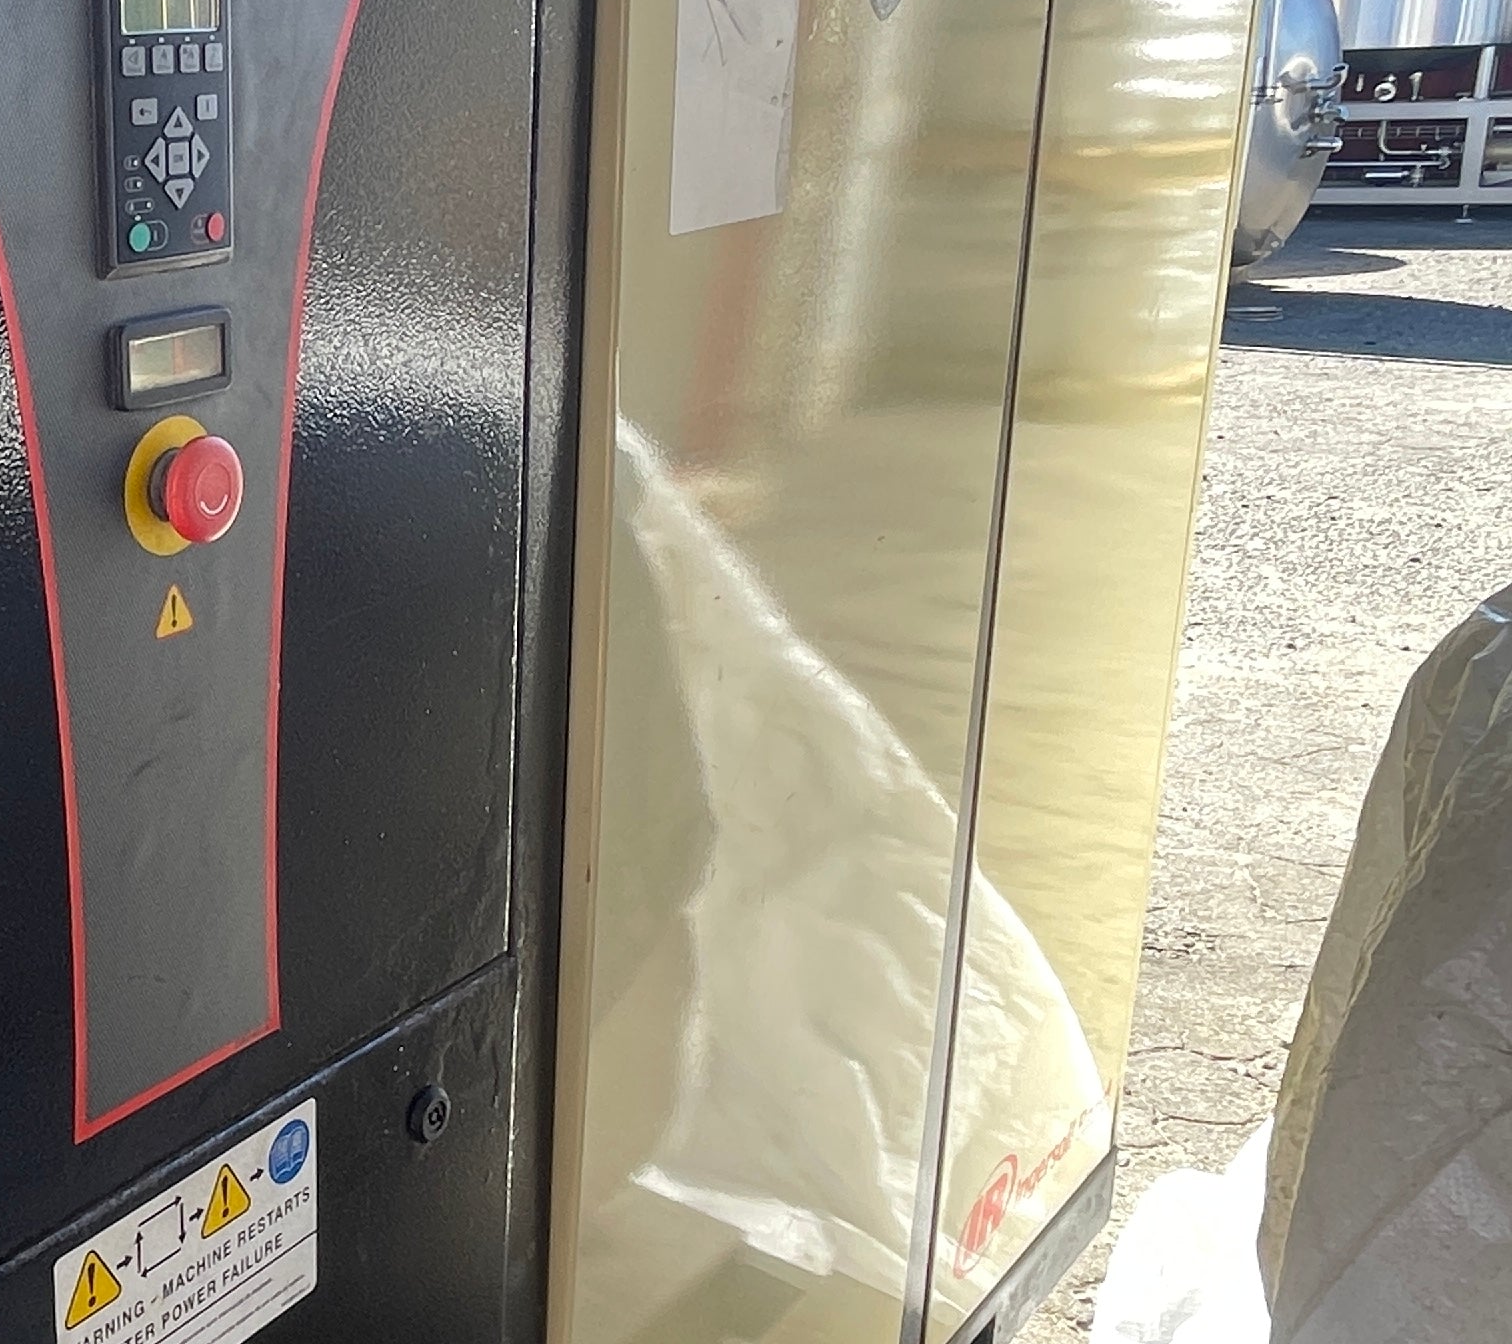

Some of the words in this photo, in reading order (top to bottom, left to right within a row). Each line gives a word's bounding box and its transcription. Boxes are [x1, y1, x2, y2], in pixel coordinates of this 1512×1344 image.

[162, 1240, 232, 1300] MACHINE
[237, 1186, 311, 1247] RESTARTS
[162, 1279, 216, 1330] POWER
[222, 1232, 284, 1287] FAILURE
